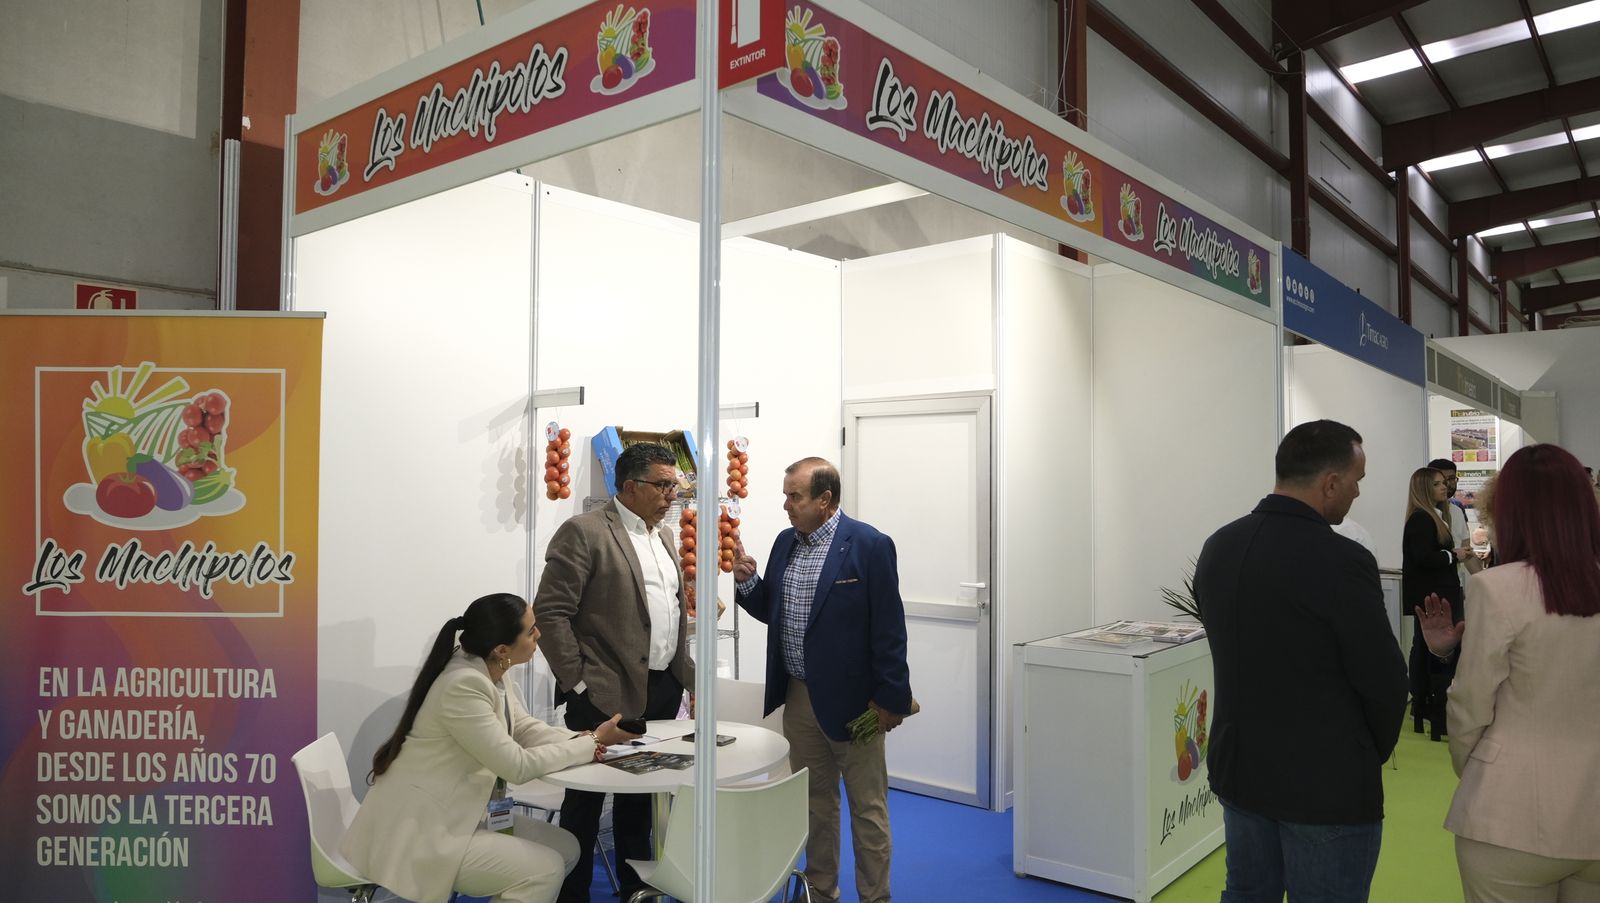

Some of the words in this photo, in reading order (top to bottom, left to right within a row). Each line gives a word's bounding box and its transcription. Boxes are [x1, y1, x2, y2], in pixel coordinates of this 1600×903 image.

[730, 48, 766, 70] EXTINTOR
[365, 110, 405, 179] Los
[411, 45, 567, 141] Machipolos
[867, 59, 916, 141] Los
[925, 92, 1048, 188] Machipolos
[1154, 203, 1176, 255] Los
[24, 540, 86, 593] Los
[98, 540, 294, 597] Machipolos
[39, 667, 68, 697] EN
[77, 667, 107, 697] LA
[113, 667, 277, 698] AGRICULTURA
[38, 709, 53, 739] Y
[59, 705, 205, 744] GANADERÍA,
[37, 752, 115, 782] DESDE
[122, 752, 167, 783] LOS
[173, 747, 238, 783] AÑOS
[245, 753, 277, 784] 70
[36, 794, 122, 825] SOMOS
[128, 795, 158, 825] LA
[164, 795, 273, 826] TERCERA
[1160, 807, 1176, 846] Los
[36, 832, 189, 867] GENERACIÓN
